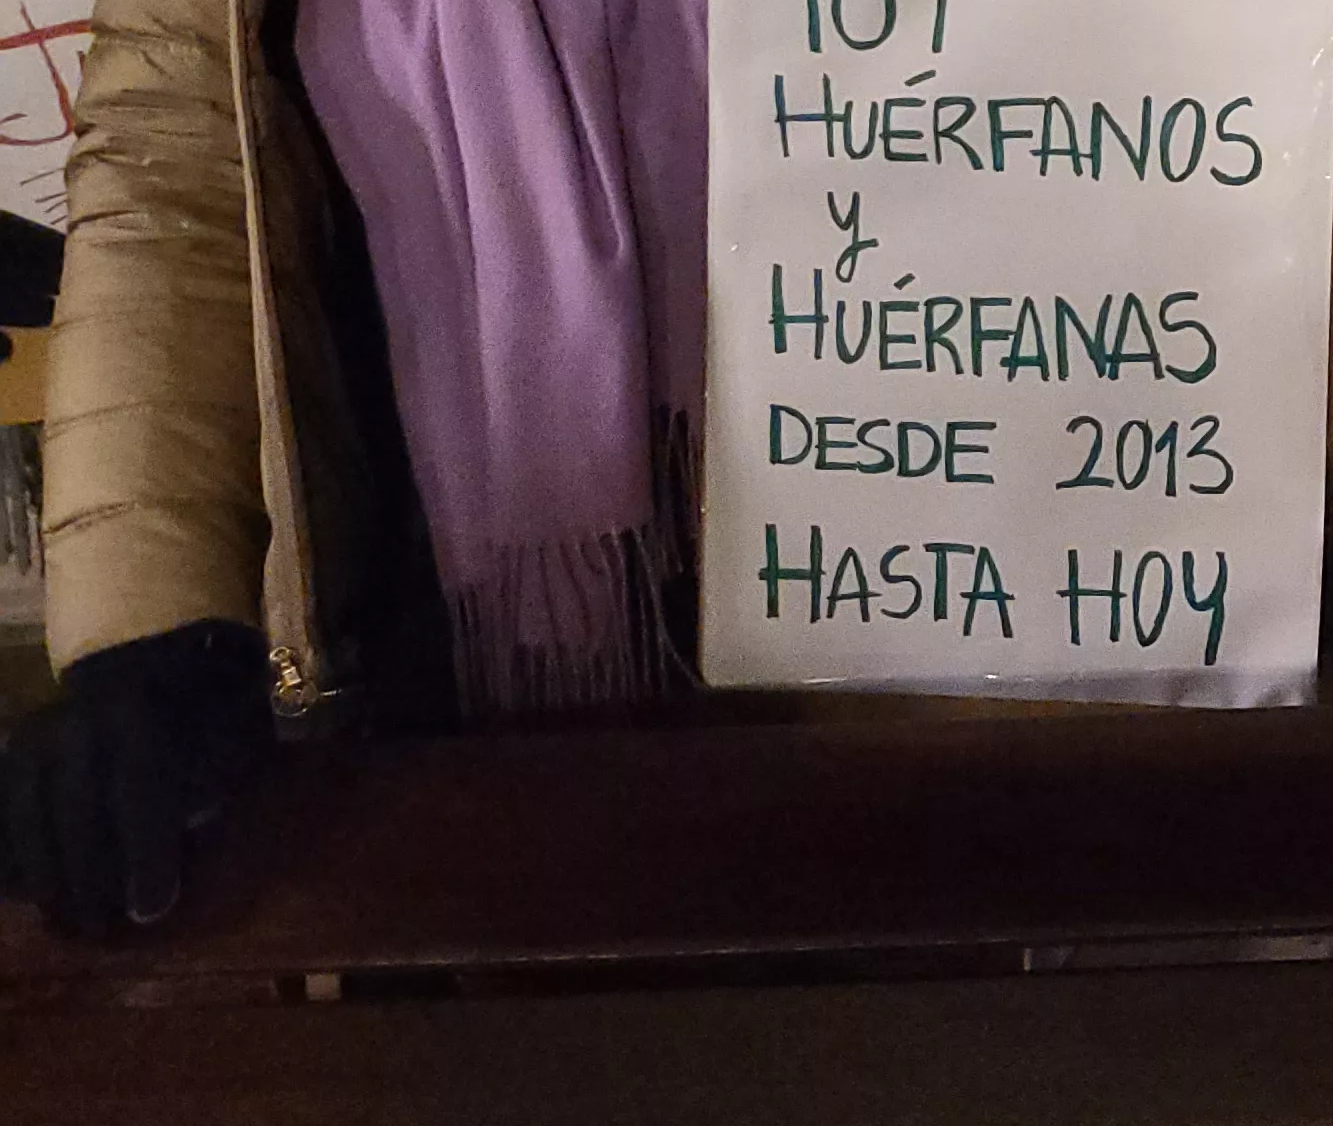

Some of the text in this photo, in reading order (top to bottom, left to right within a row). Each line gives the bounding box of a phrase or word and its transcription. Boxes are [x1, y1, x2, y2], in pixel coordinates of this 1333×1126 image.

[774, 69, 1264, 189] HUÉRFANOS
[769, 263, 1217, 384] HUÉRFANAS
[769, 402, 1236, 498] DESDE 2013
[758, 523, 1230, 665] HASTA HOY
